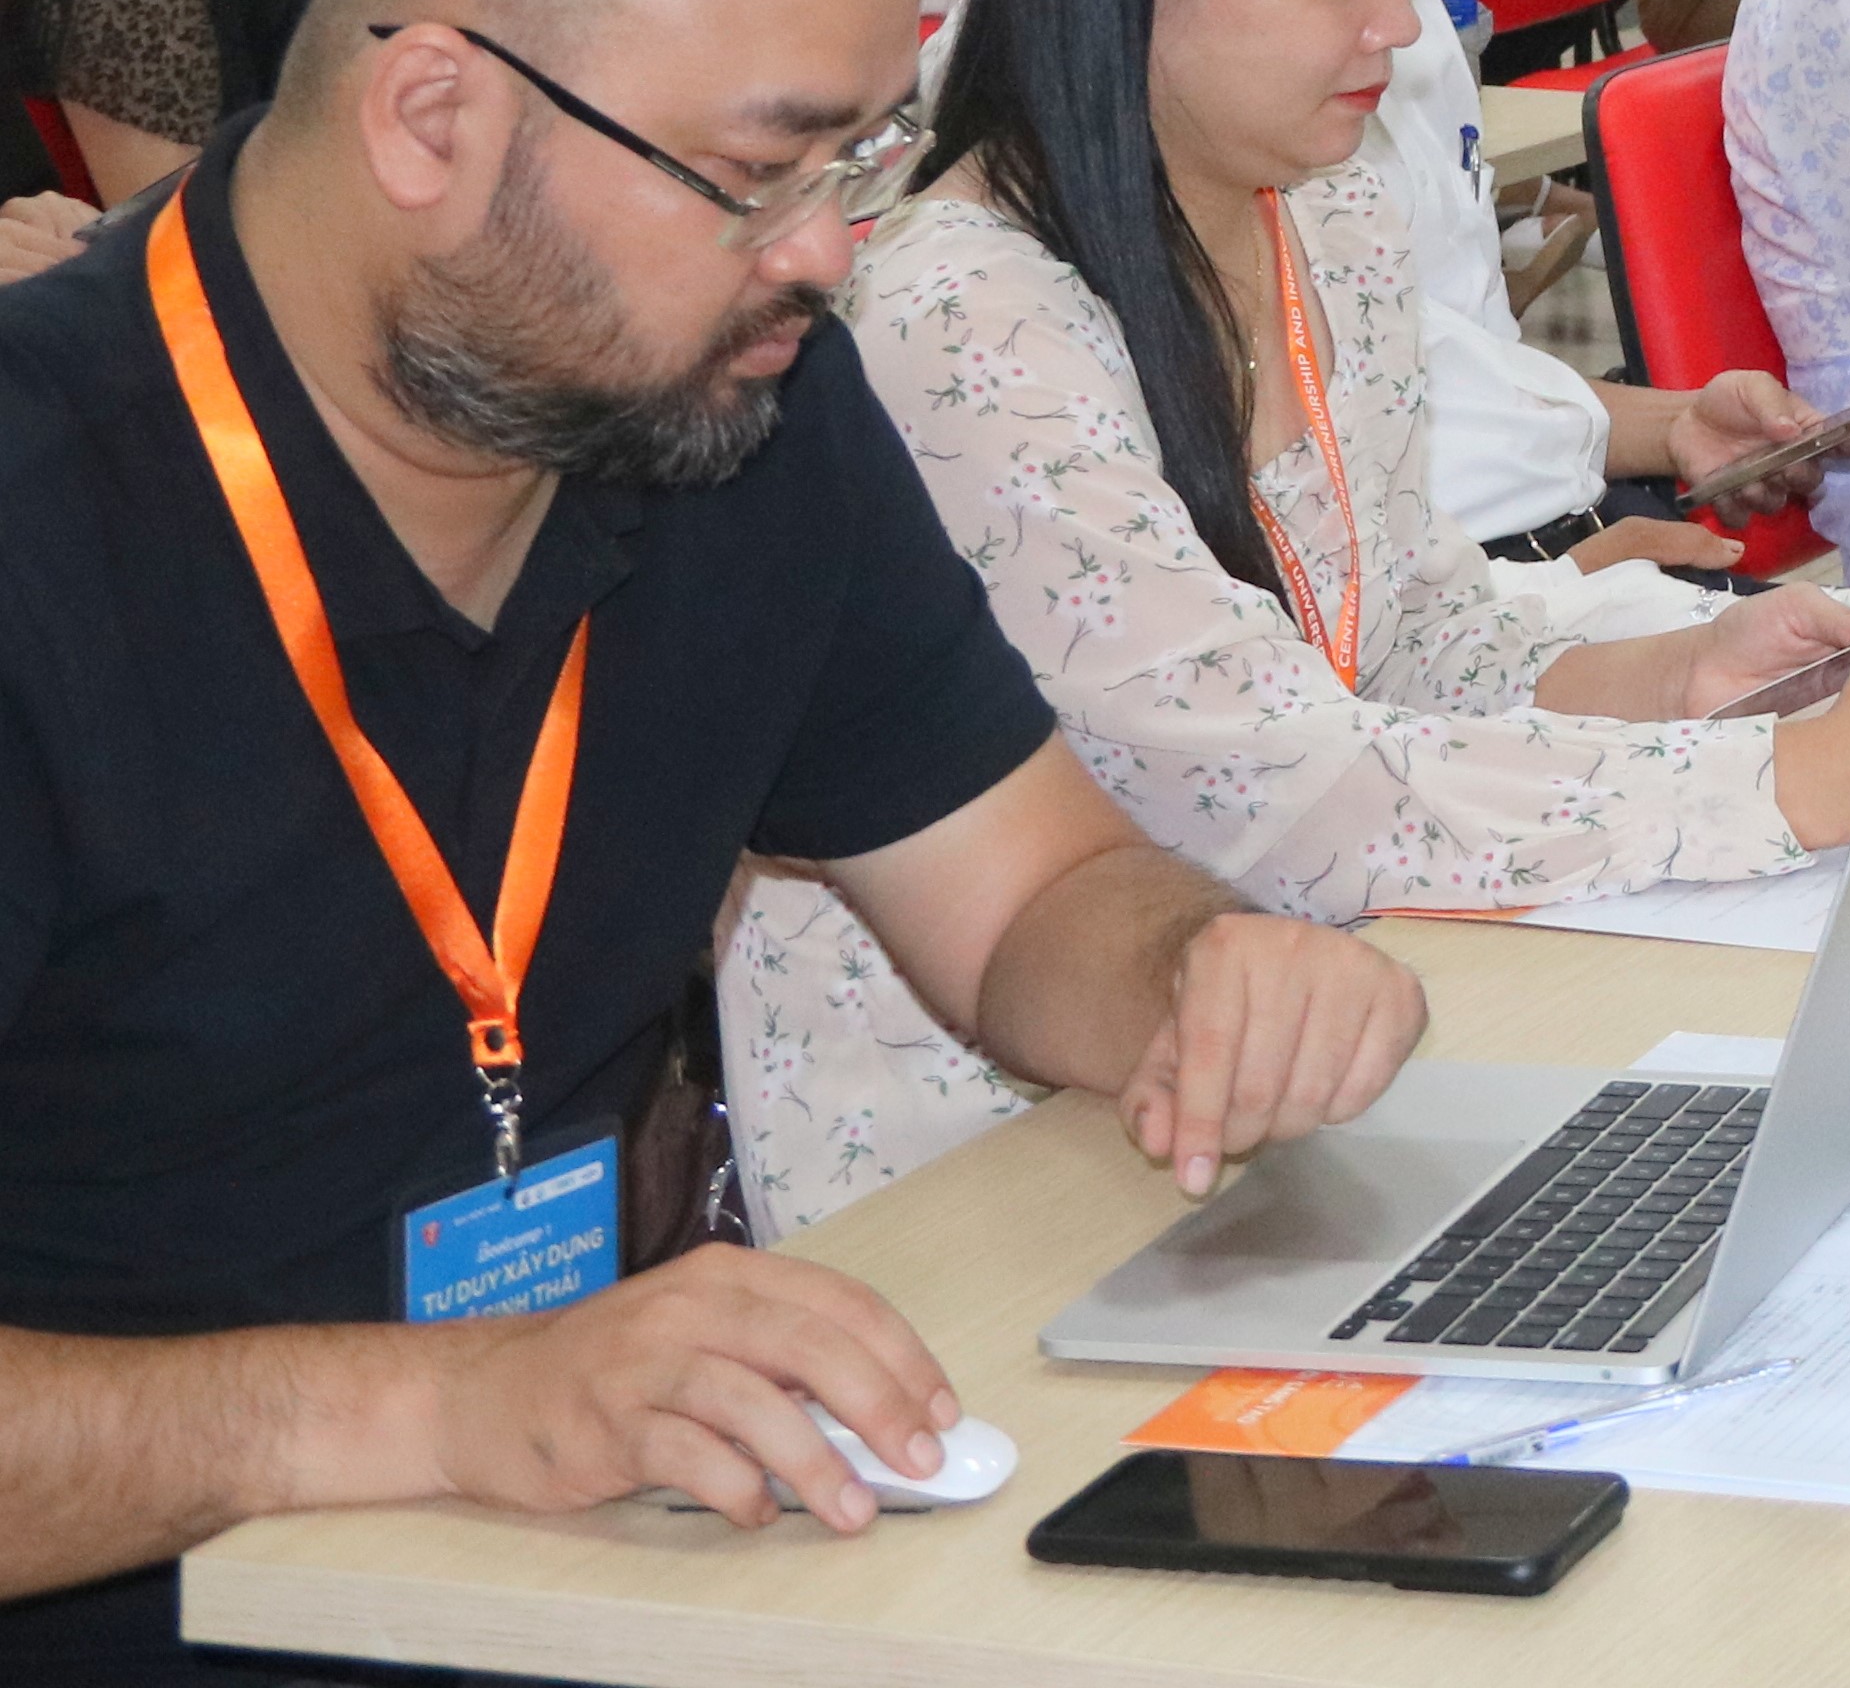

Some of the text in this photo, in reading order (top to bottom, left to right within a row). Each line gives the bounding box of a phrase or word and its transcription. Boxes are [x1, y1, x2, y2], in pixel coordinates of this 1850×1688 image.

[1289, 306, 1307, 348] AND
[1272, 523, 1294, 562] HUE
[1338, 591, 1359, 669] CENTER
[455, 1268, 501, 1303] DUY
